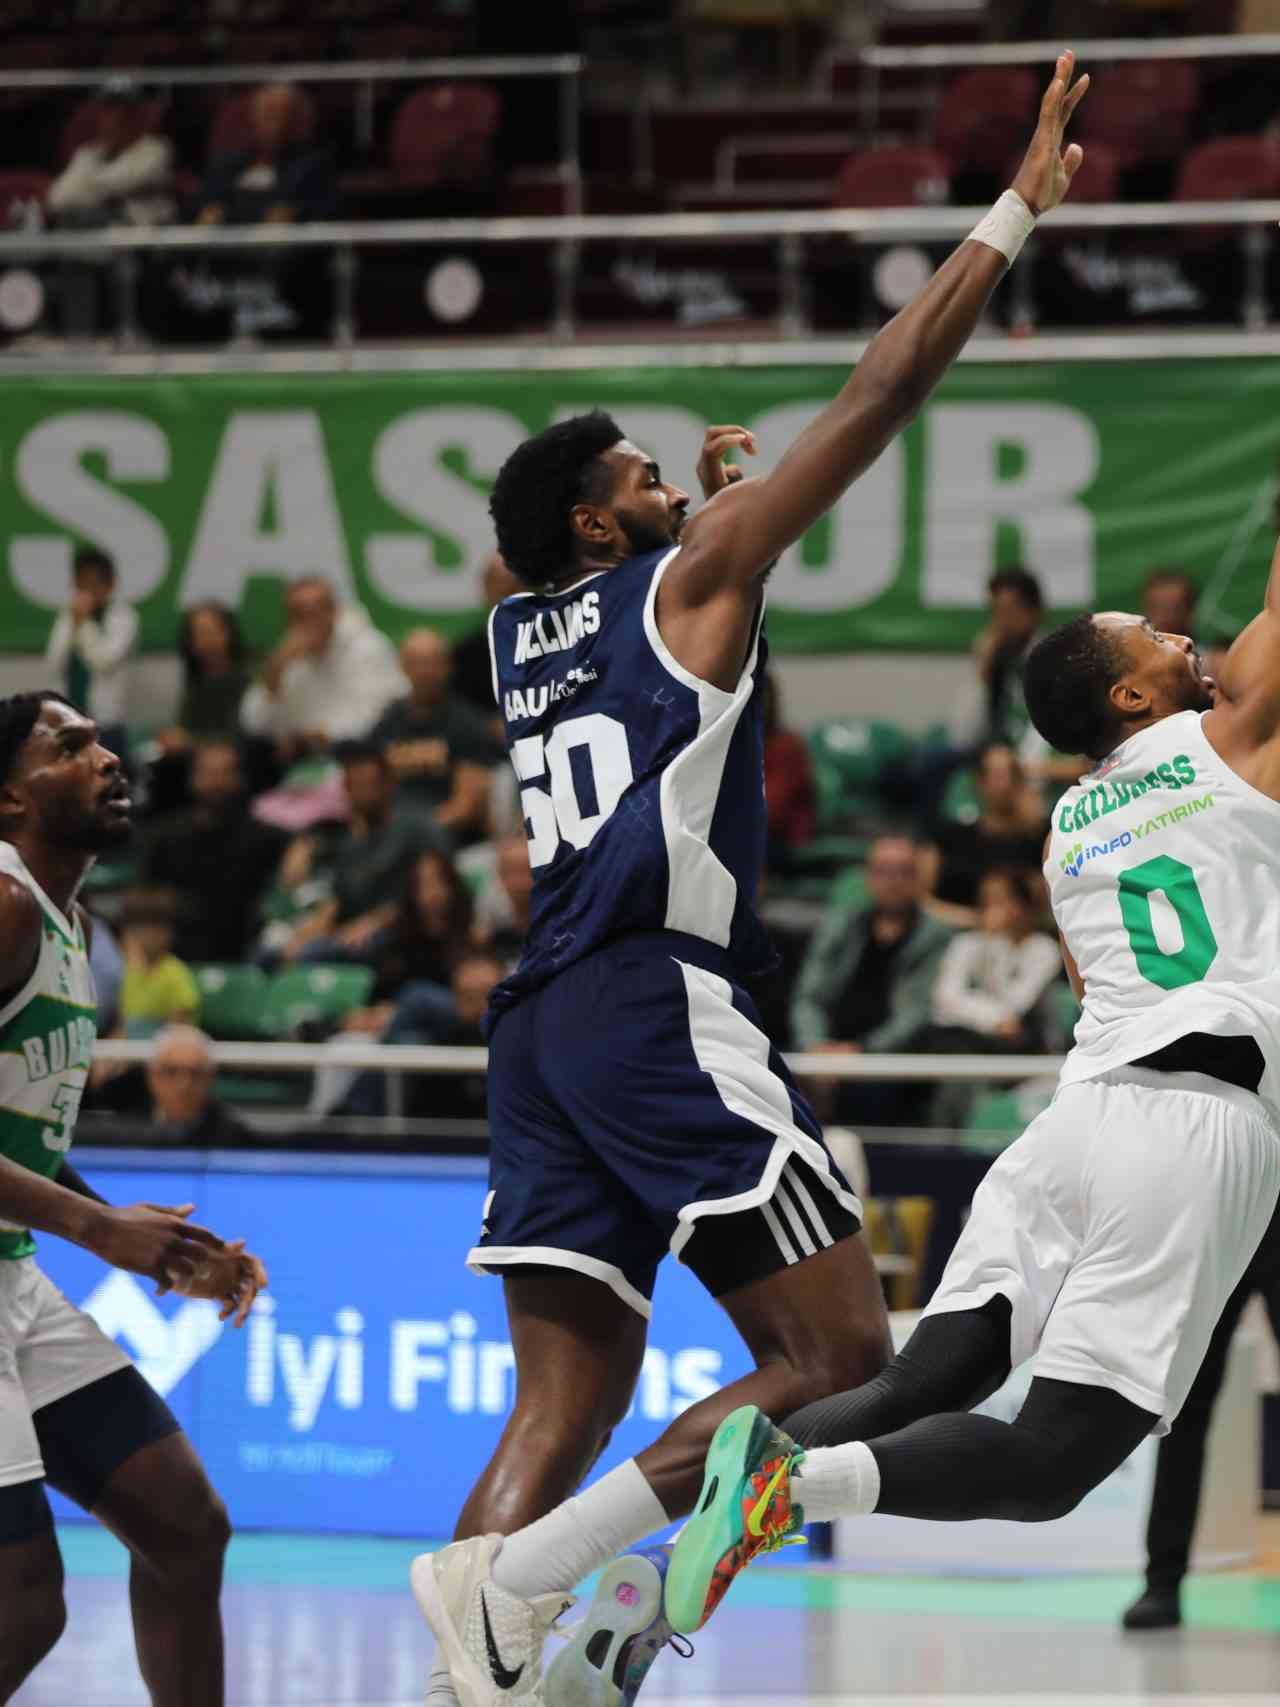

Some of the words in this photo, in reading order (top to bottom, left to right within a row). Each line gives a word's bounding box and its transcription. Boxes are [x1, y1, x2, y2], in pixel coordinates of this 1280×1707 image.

[509, 713, 634, 868] 50
[1118, 854, 1218, 991] 0
[390, 1311, 723, 1420] Finns
